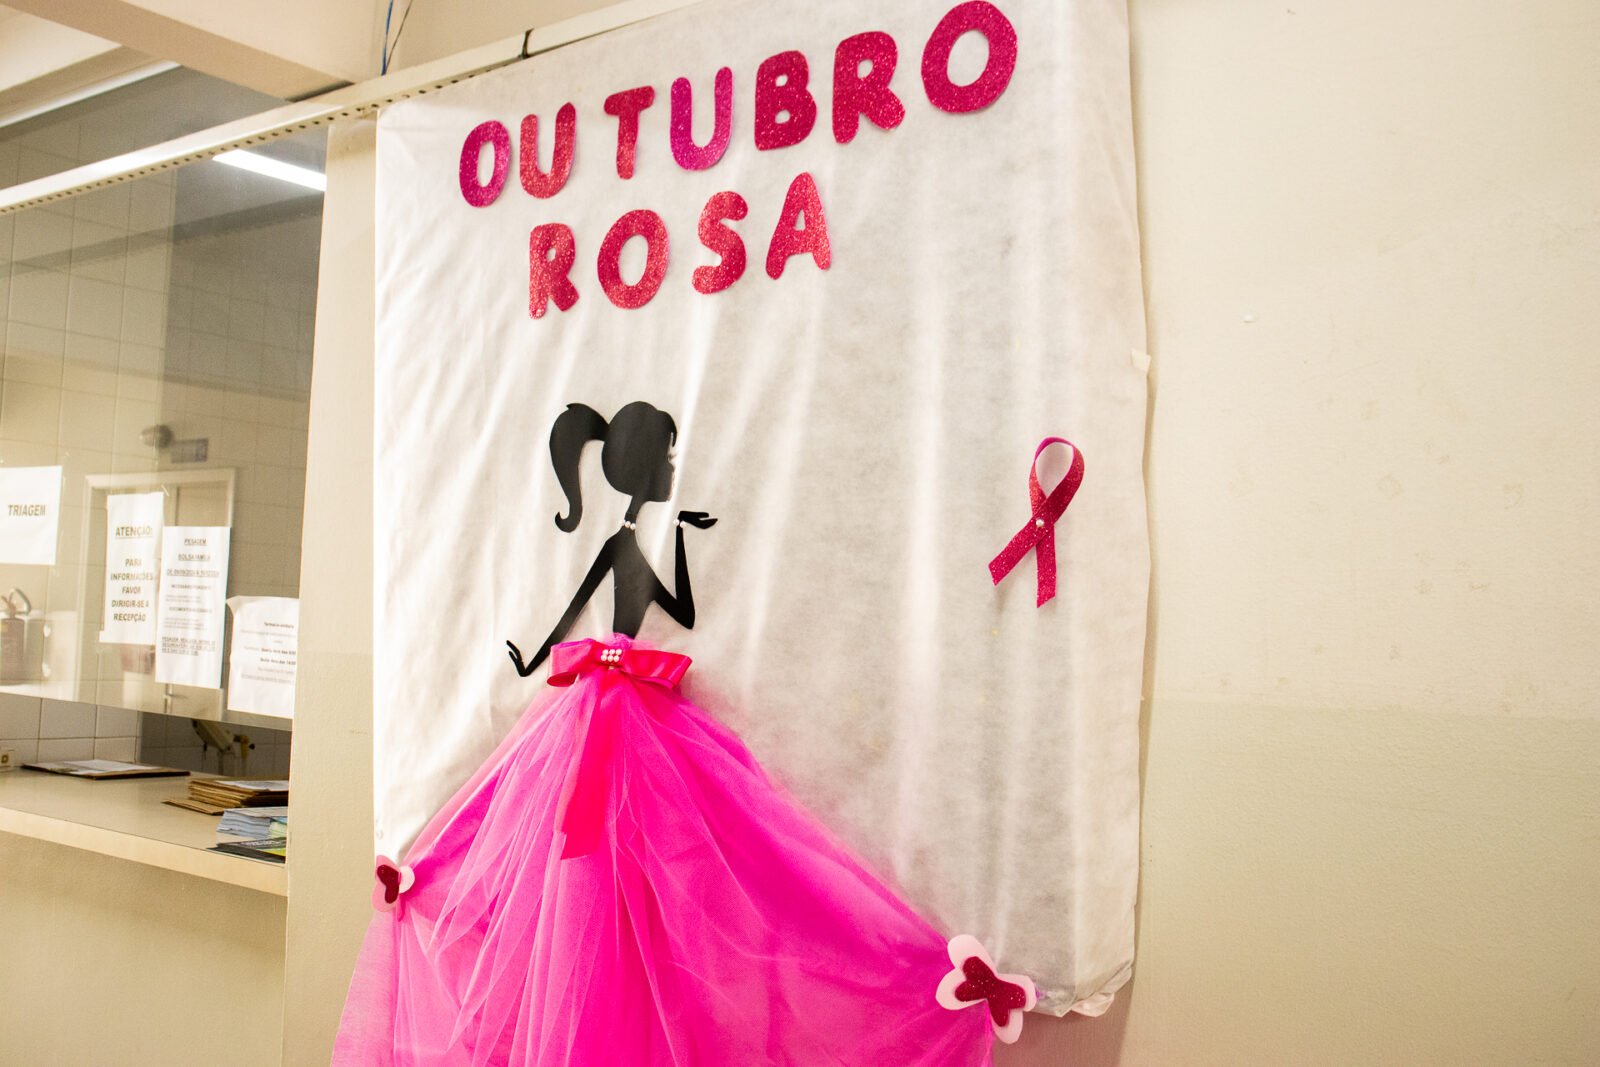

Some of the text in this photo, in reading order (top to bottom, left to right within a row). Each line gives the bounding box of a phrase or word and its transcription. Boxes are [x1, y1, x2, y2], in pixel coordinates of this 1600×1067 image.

[459, 0, 1017, 208] OUTUBRO
[529, 172, 832, 319] ROSA
[8, 504, 46, 516] TRIAGEM
[125, 558, 142, 567] PARA
[121, 586, 141, 594] FAVOR
[113, 612, 146, 622] RECEPÇÃO
